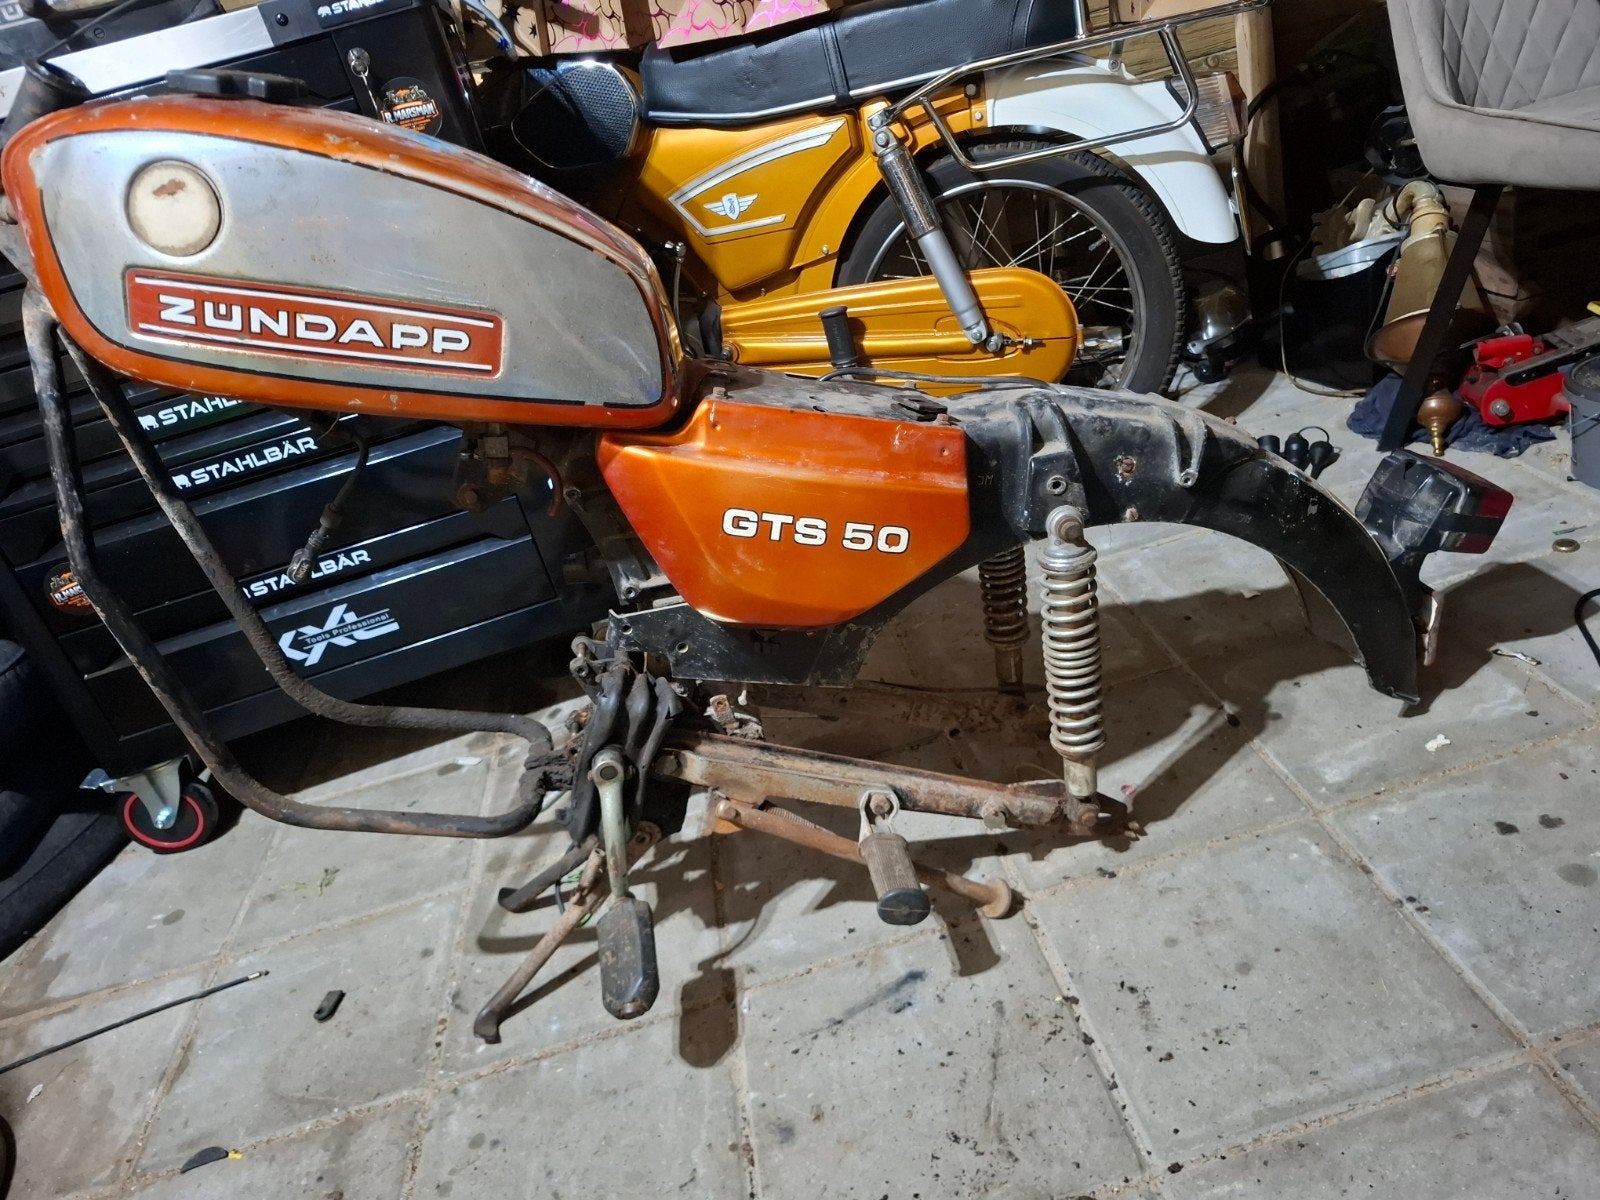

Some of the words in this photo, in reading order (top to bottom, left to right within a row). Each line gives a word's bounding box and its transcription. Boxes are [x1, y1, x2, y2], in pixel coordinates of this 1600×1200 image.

[157, 293, 471, 354] ZÜNDAPP
[157, 396, 243, 426] STAHL
[190, 436, 318, 485] STAHLBÄR
[722, 507, 828, 547] GTS
[841, 521, 910, 555] 50
[249, 549, 372, 597] STALBÄR
[304, 632, 331, 645] Tools
[331, 612, 390, 636] Professional
